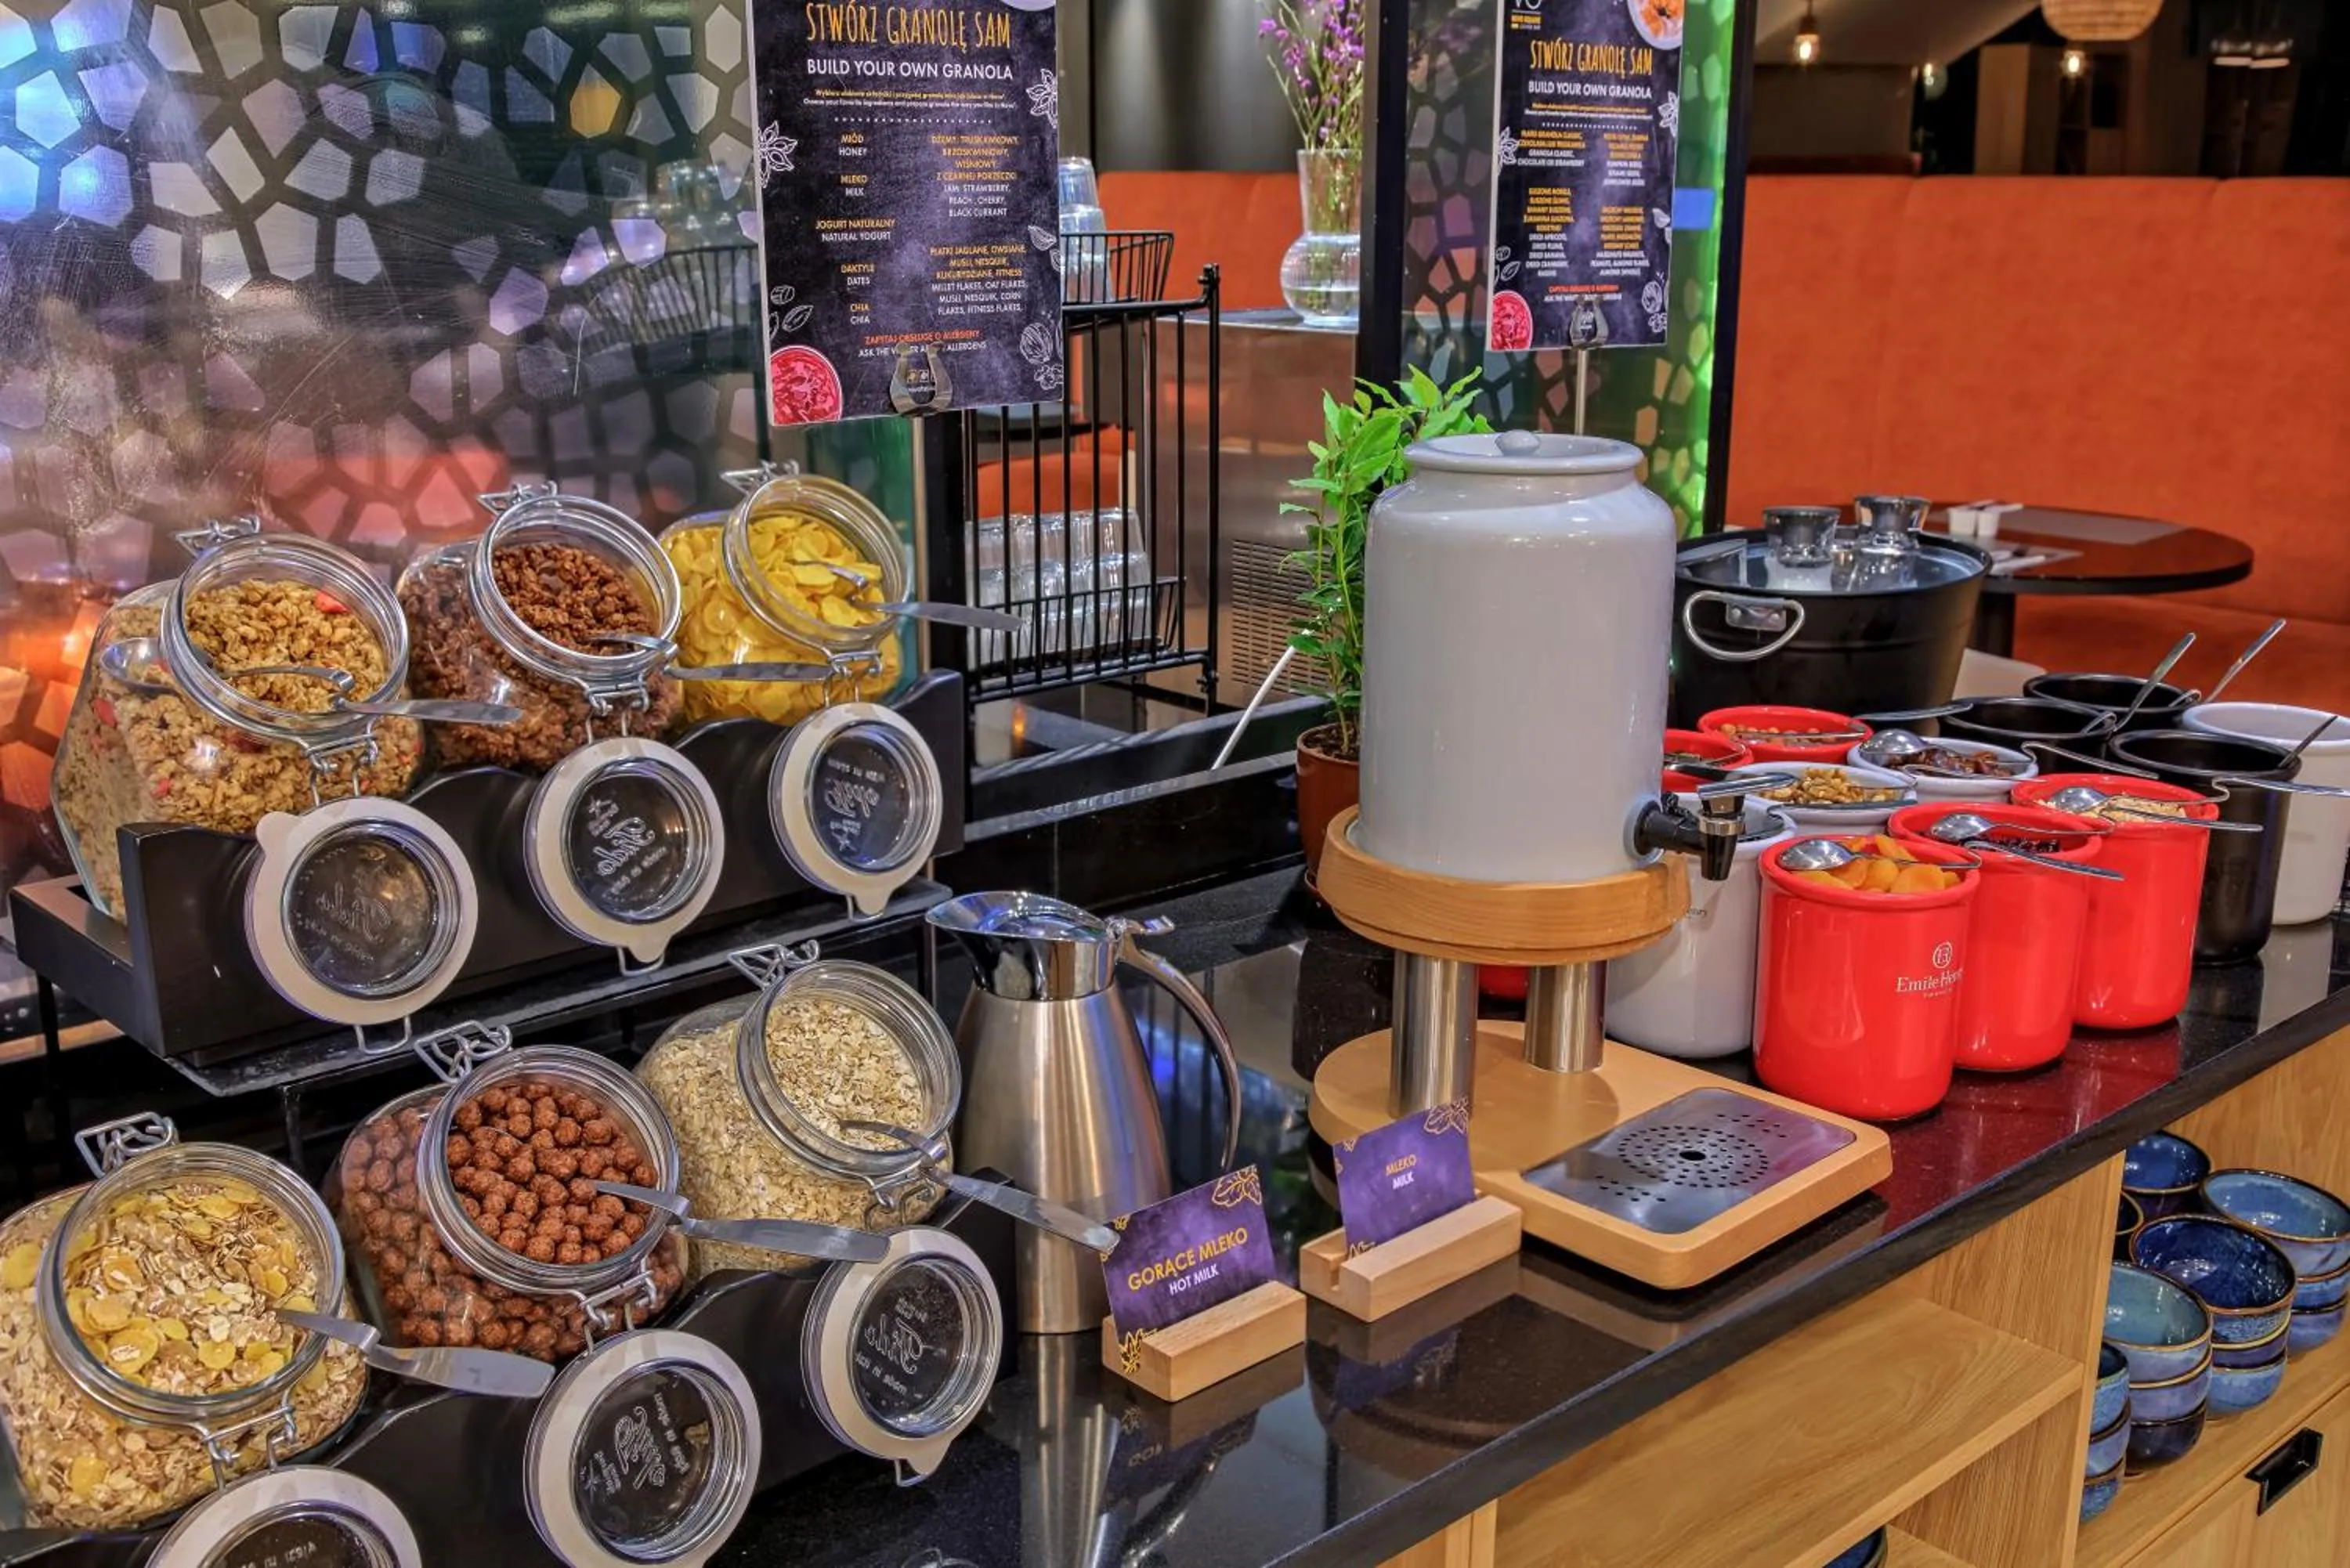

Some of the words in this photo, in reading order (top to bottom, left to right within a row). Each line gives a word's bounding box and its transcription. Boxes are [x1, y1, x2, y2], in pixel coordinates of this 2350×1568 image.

[806, 0, 877, 43] STWÓRZ
[886, 7, 967, 53] GRANOLĘ
[974, 12, 1010, 49] SAM
[1530, 38, 1574, 71] STWÓRZ
[1577, 43, 1626, 79] GRANOLĘ
[1629, 47, 1652, 75] SAM
[808, 60, 850, 74] BUILD
[855, 60, 895, 76] YOUR
[900, 62, 938, 77] OWN
[942, 63, 1013, 80] GRANOLA
[1528, 81, 1555, 94] BUILD
[1556, 82, 1581, 96] YOUR
[1583, 83, 1607, 96] OWN
[1608, 85, 1652, 99] GRANOLA
[839, 146, 867, 156] HONEY
[841, 175, 868, 184] MLEKO
[845, 187, 864, 197] MILK
[815, 220, 848, 229] JOGURT
[848, 219, 896, 228] NATURALNY
[822, 233, 858, 242] NATURAL
[860, 231, 891, 240] YOGURT
[847, 276, 870, 286] DATES
[850, 303, 870, 313] CHIA
[850, 316, 870, 325] CHIA
[859, 349, 874, 358] ASK
[876, 347, 890, 356] THE
[1896, 976, 1938, 992] Emile
[1386, 1154, 1417, 1176] MLEKO
[1393, 1171, 1414, 1190] MILK
[1127, 1248, 1196, 1291] GORĄCE
[1198, 1227, 1248, 1263] MLEKO
[1169, 1276, 1191, 1295] HOT
[1193, 1263, 1219, 1285] MILK
